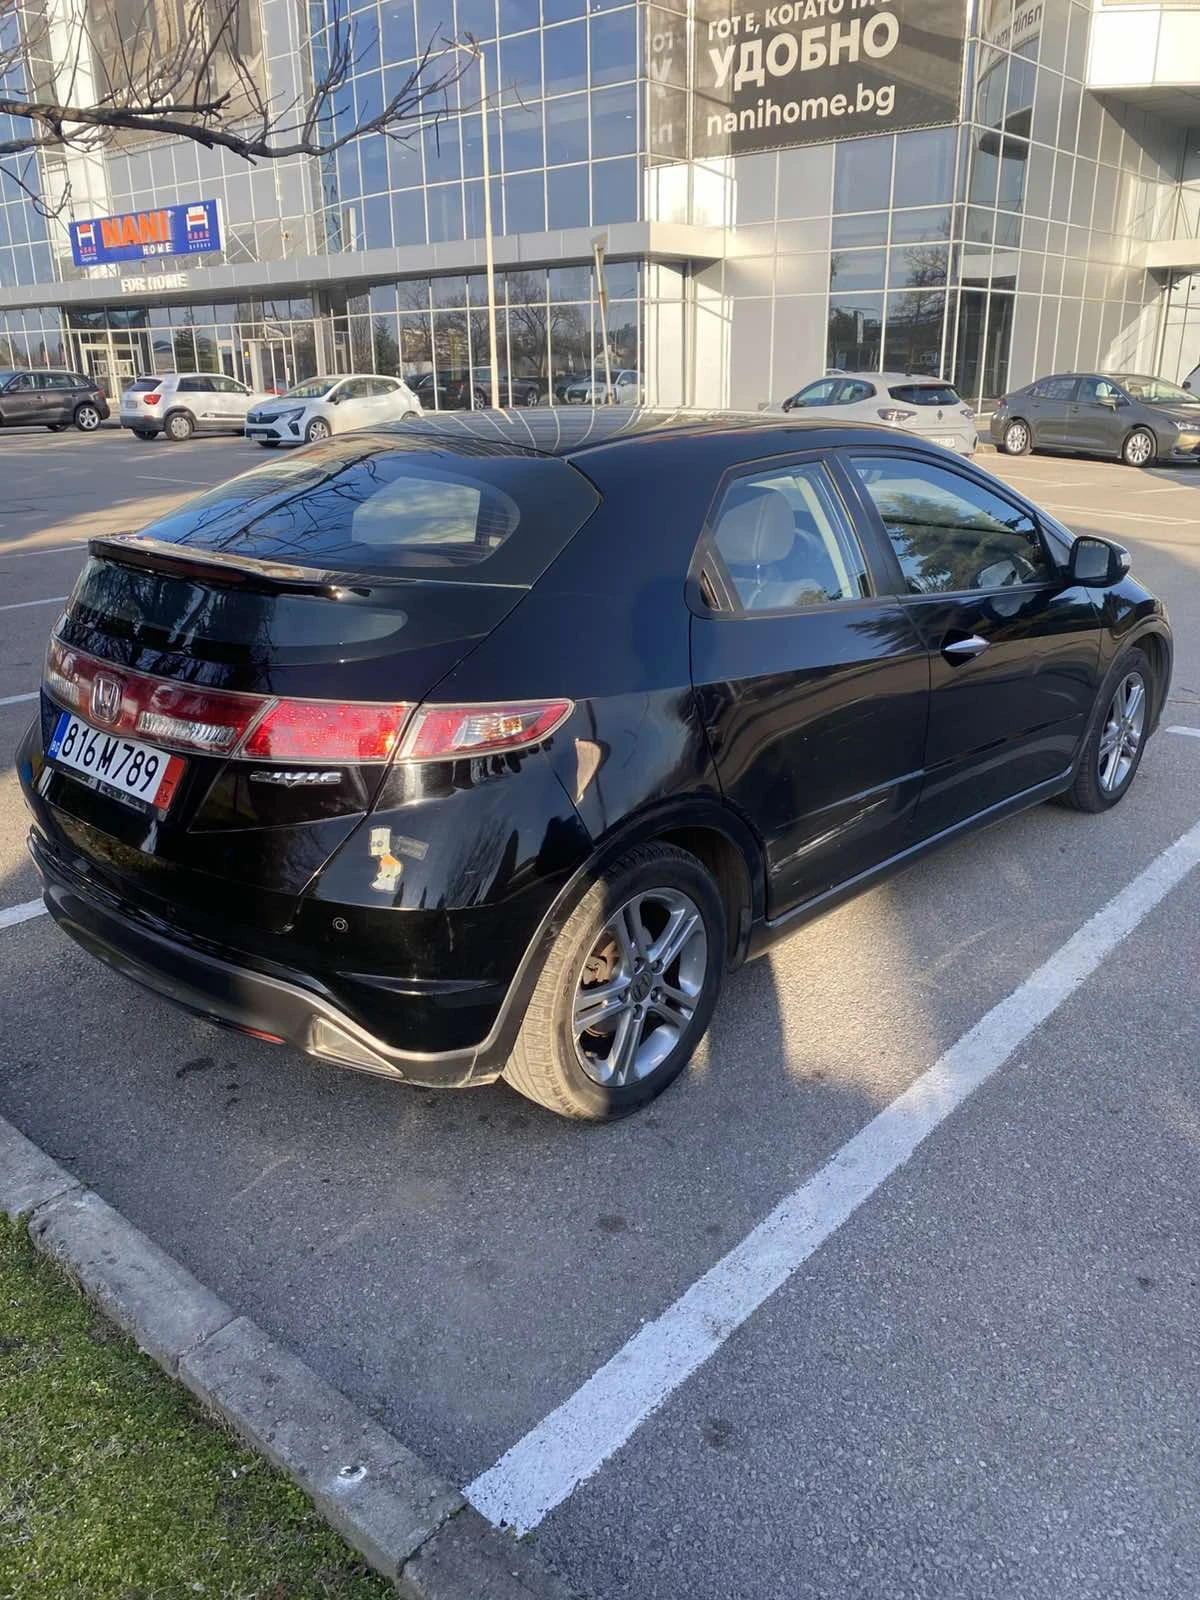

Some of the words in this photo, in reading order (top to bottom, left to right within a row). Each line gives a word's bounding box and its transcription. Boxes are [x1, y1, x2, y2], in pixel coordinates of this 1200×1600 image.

[708, 15, 741, 41] ГОТ
[765, 0, 844, 28] КОГАТО
[708, 11, 900, 92] УДОБНО
[706, 81, 896, 137] nanihome.bg
[101, 209, 173, 249] NANI
[142, 242, 173, 257] HOME
[120, 277, 146, 293] FOR
